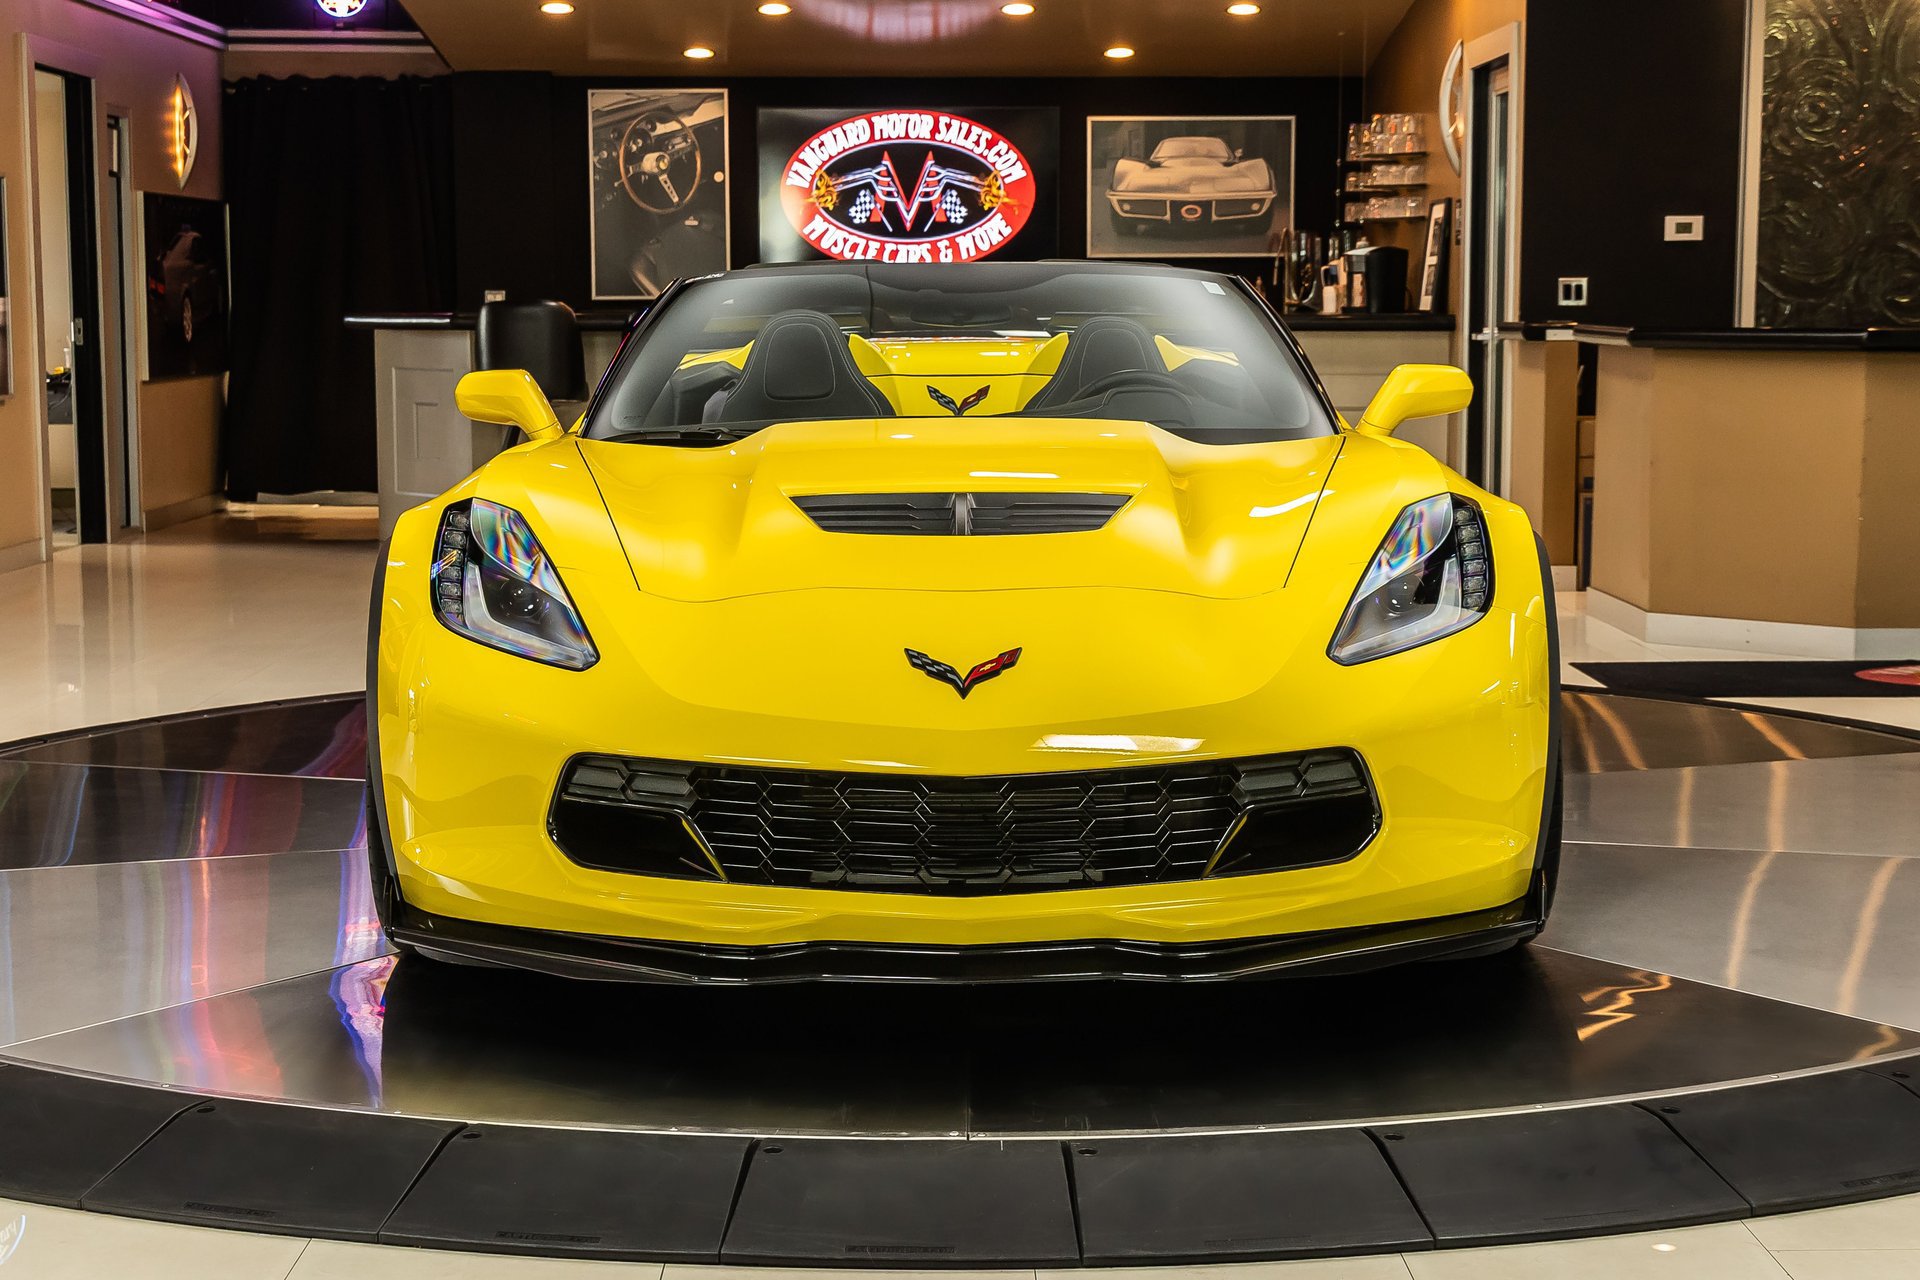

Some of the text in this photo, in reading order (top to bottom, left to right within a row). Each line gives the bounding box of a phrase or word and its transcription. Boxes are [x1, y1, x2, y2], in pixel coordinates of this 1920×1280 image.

[785, 112, 1028, 188] VANGUARD MOTOR SALES.COM
[802, 212, 1013, 263] MUSCLE CARS & MORE
